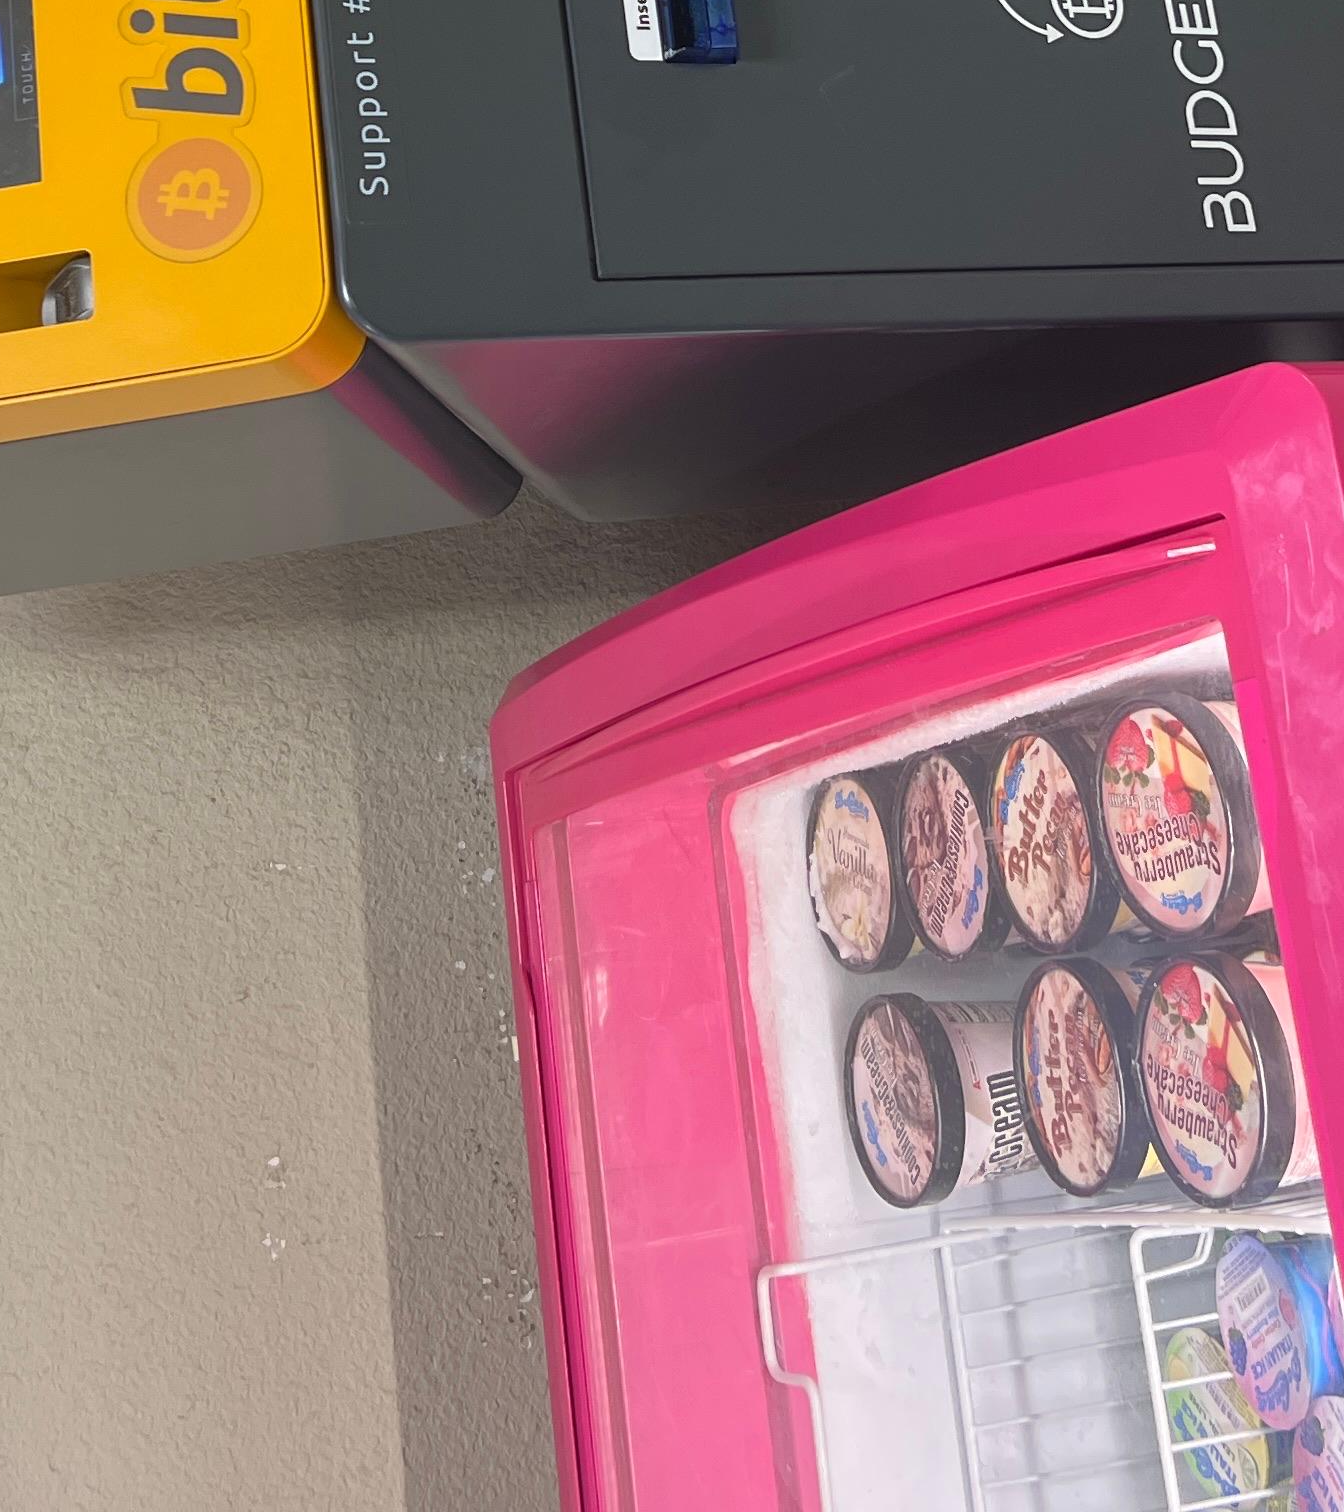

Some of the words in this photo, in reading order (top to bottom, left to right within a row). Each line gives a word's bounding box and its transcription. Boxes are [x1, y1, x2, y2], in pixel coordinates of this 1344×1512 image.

[346, 31, 391, 196] Support
[1007, 768, 1048, 887] Butter
[1031, 791, 1068, 876] Pecan
[1114, 812, 1201, 861] Cheesecake
[1141, 795, 1166, 820] Ice
[1133, 840, 1222, 881] Strawberry
[1044, 1008, 1073, 1158] Butter
[1064, 1012, 1083, 1122] Pecan
[1146, 1053, 1228, 1131] Cheesecake
[1176, 1046, 1201, 1071] Ice
[985, 1069, 1024, 1163] Cream
[1155, 1093, 1239, 1169] Strawberry
